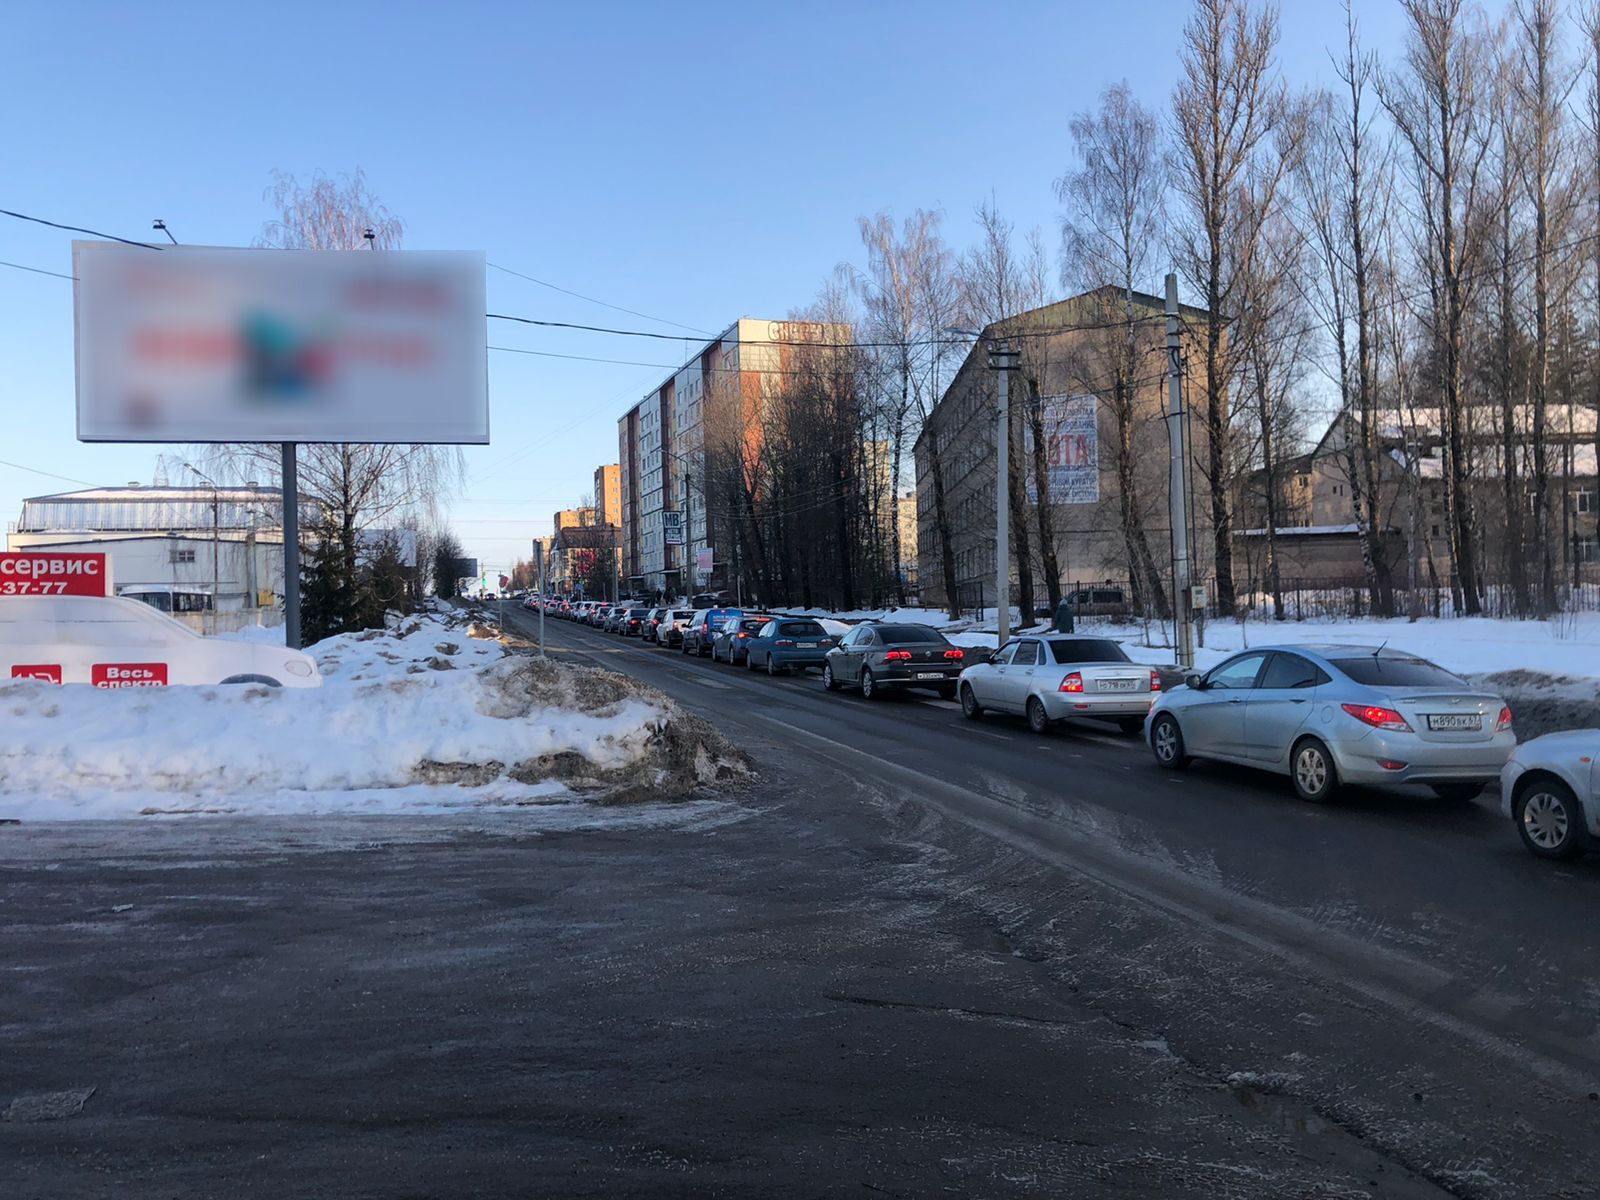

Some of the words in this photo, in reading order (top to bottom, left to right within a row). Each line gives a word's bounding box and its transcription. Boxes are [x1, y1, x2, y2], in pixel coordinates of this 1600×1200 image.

[0, 559, 98, 579] сервис
[0, 581, 67, 594] 37-77
[107, 667, 153, 679] Весь
